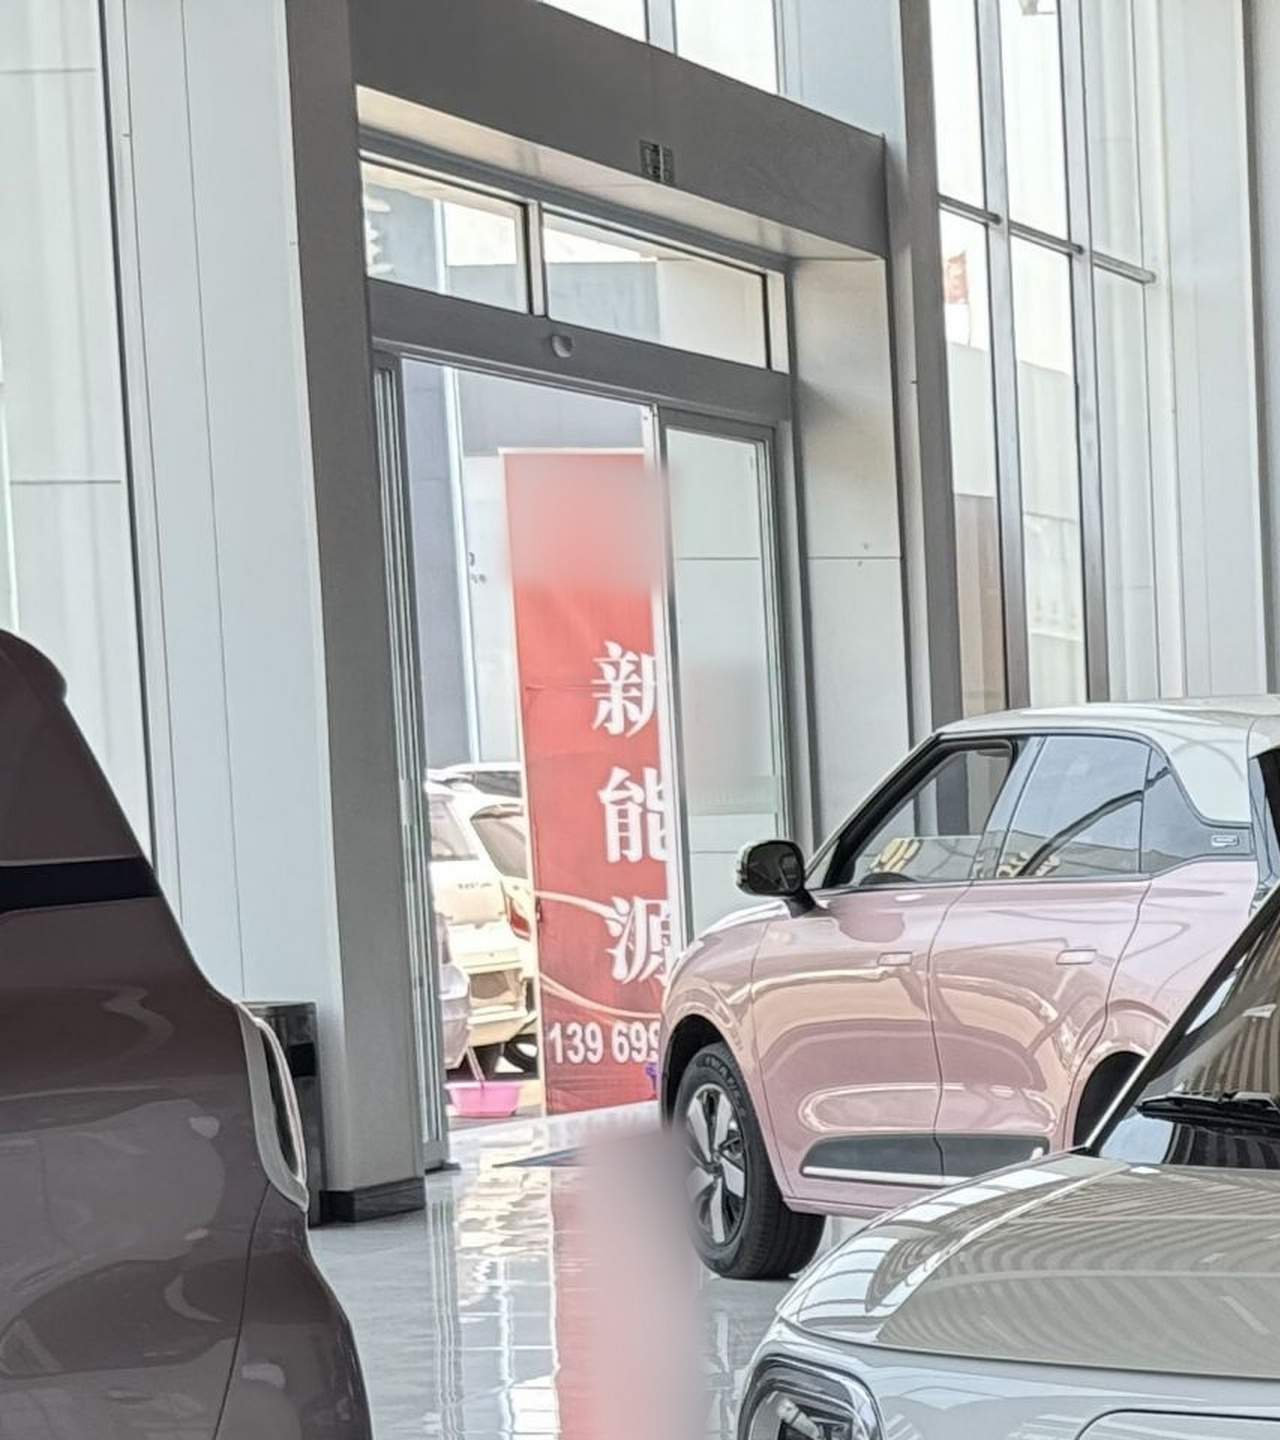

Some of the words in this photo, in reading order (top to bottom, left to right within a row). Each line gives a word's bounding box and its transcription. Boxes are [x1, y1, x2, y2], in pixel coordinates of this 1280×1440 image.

[590, 640, 673, 986] 新能源
[549, 1021, 603, 1064] 139
